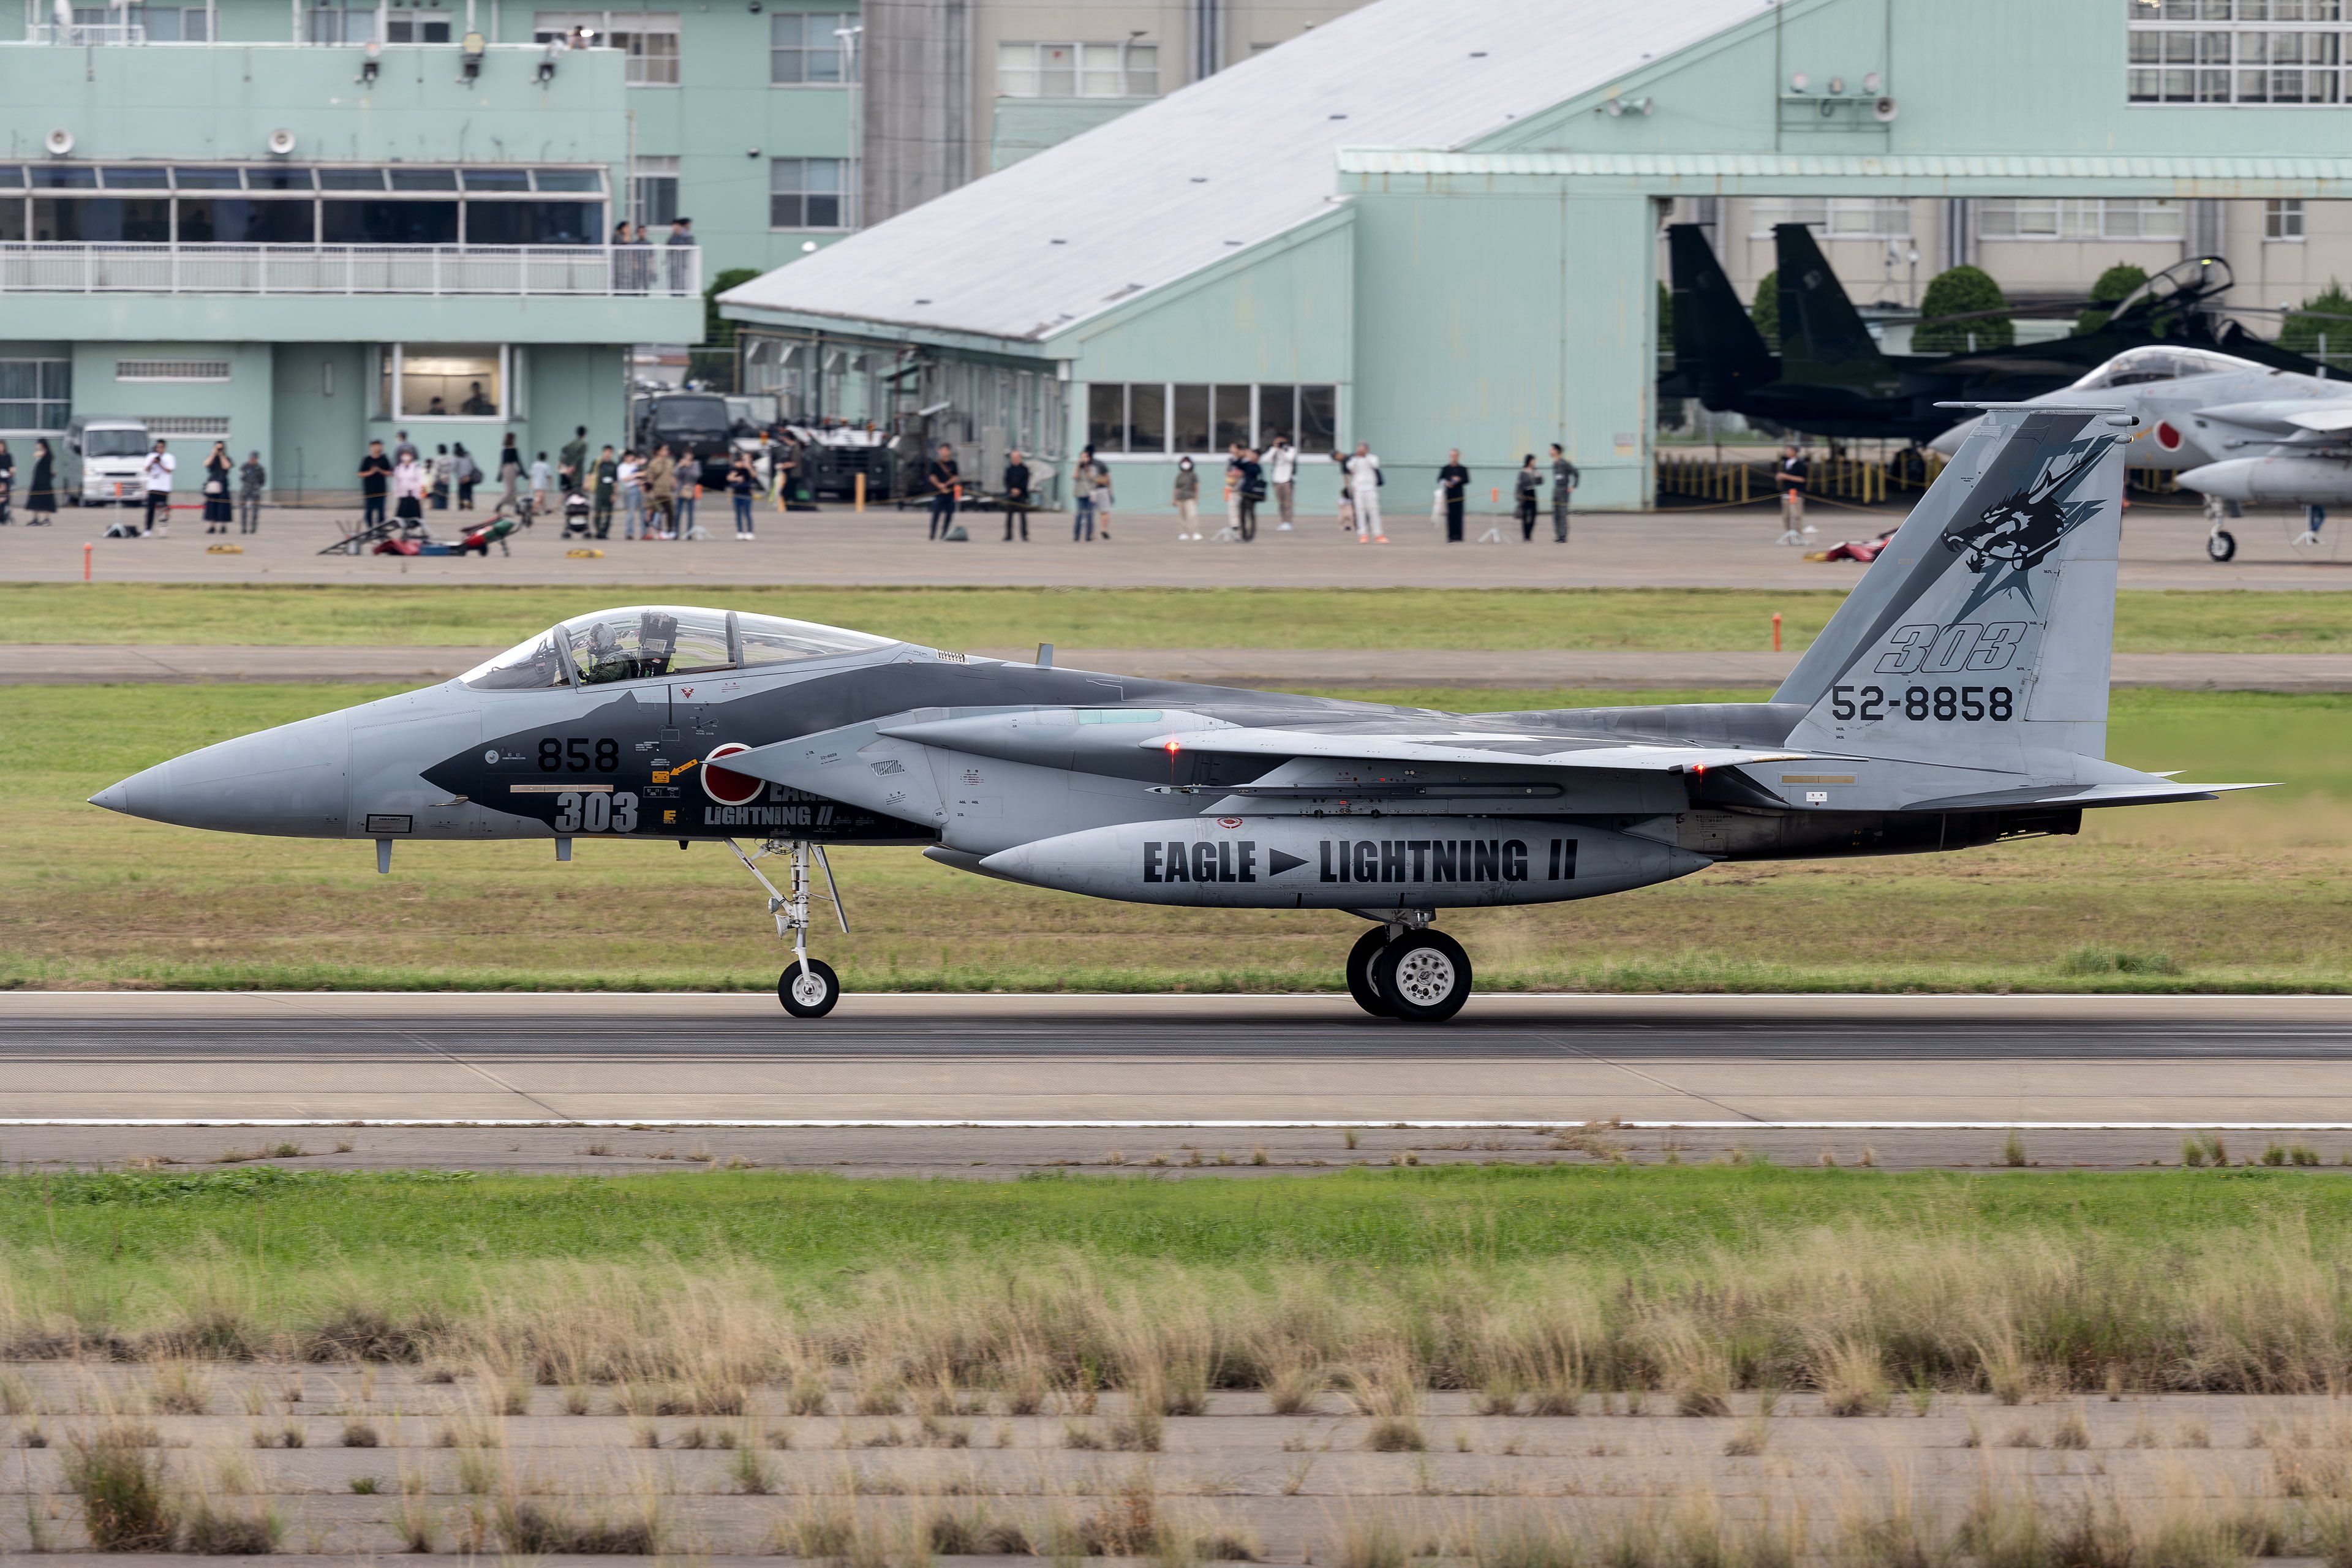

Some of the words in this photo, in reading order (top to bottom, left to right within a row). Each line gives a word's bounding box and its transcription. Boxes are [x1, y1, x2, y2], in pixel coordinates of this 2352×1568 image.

[1874, 620, 2027, 674] 303
[1831, 685, 2013, 722] 52-8858
[538, 737, 619, 772] 858
[555, 792, 638, 832] 303
[704, 806, 811, 825] LIGHTNING
[1144, 840, 1256, 883] EAGLE
[1319, 839, 1528, 883] LIGHTNING
[1548, 839, 1578, 881] II
